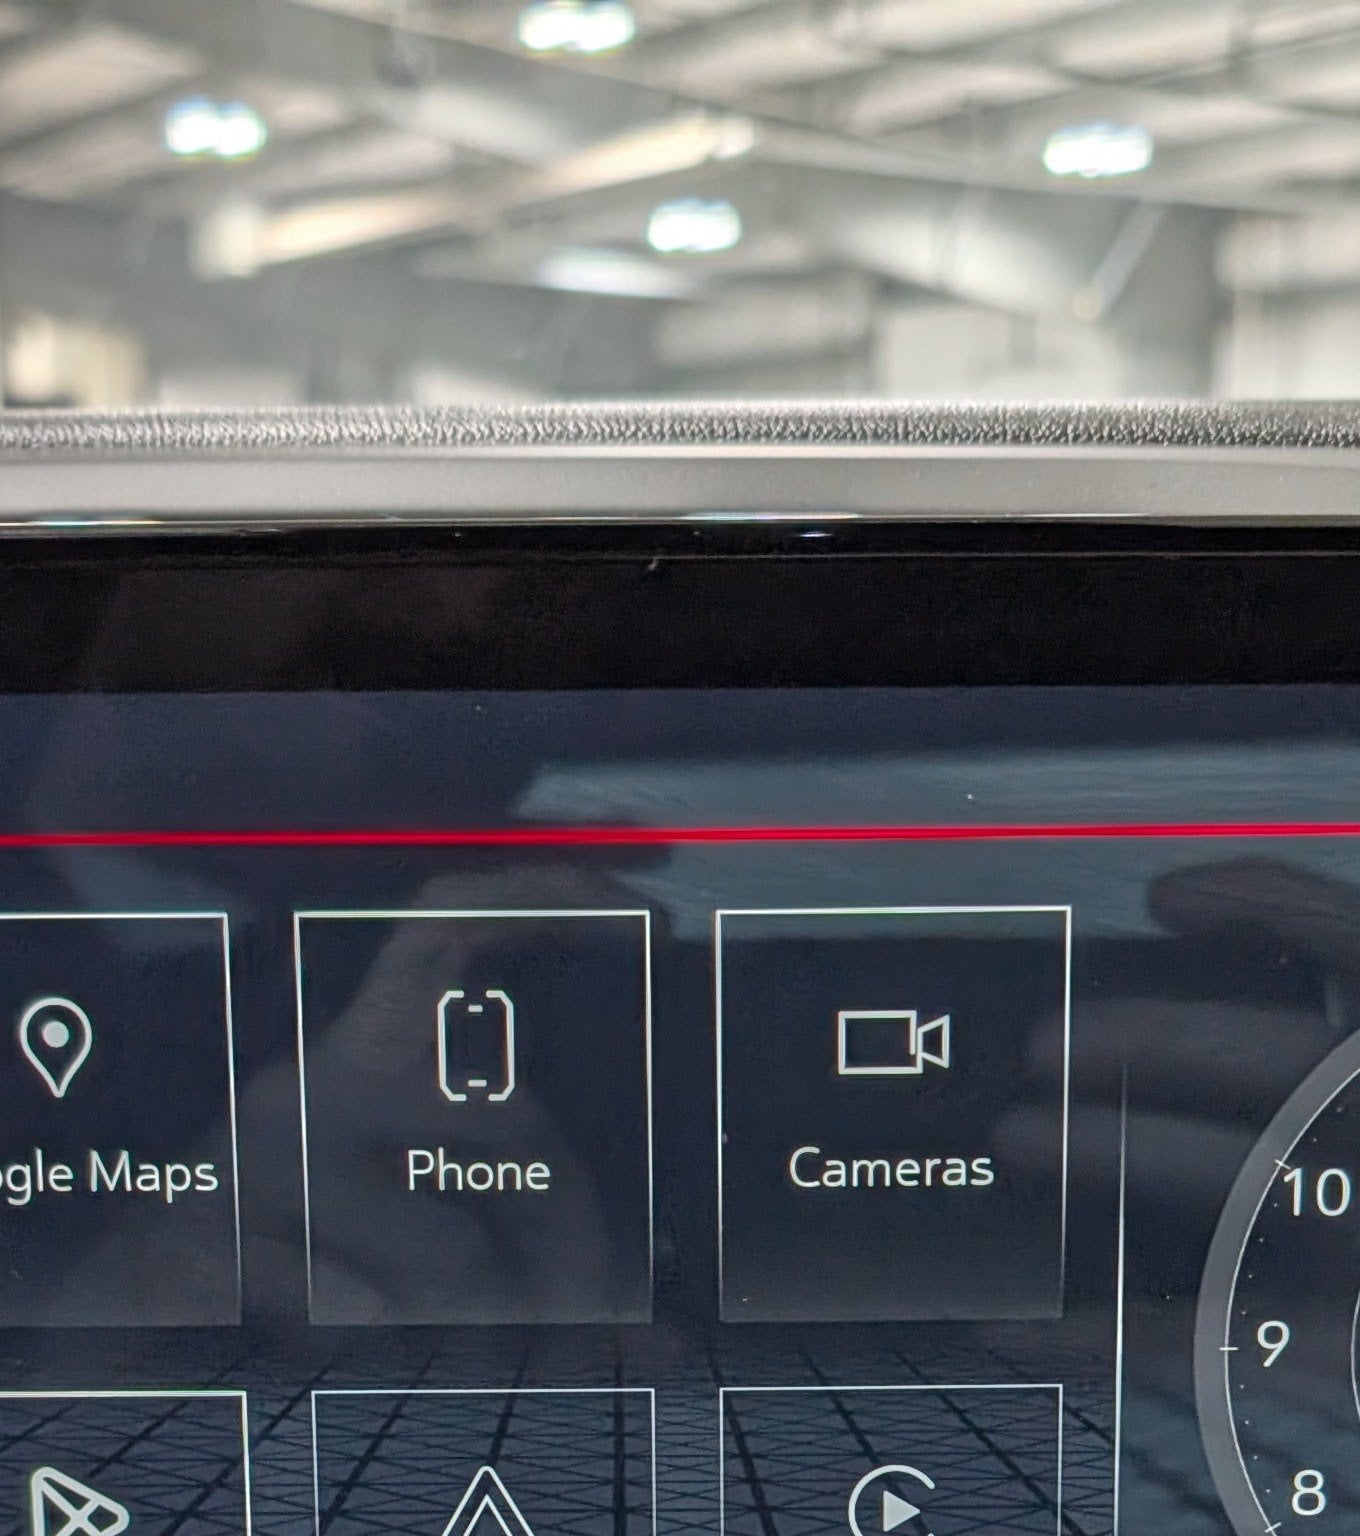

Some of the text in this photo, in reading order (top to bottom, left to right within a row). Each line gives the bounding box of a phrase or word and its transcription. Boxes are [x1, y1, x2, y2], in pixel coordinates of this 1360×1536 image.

[86, 1150, 219, 1202] Maps
[407, 1147, 551, 1191] Phone
[789, 1146, 995, 1188] Cameras
[1283, 1168, 1351, 1217] 10
[1257, 1320, 1290, 1368] 9
[1291, 1469, 1327, 1516] 8
